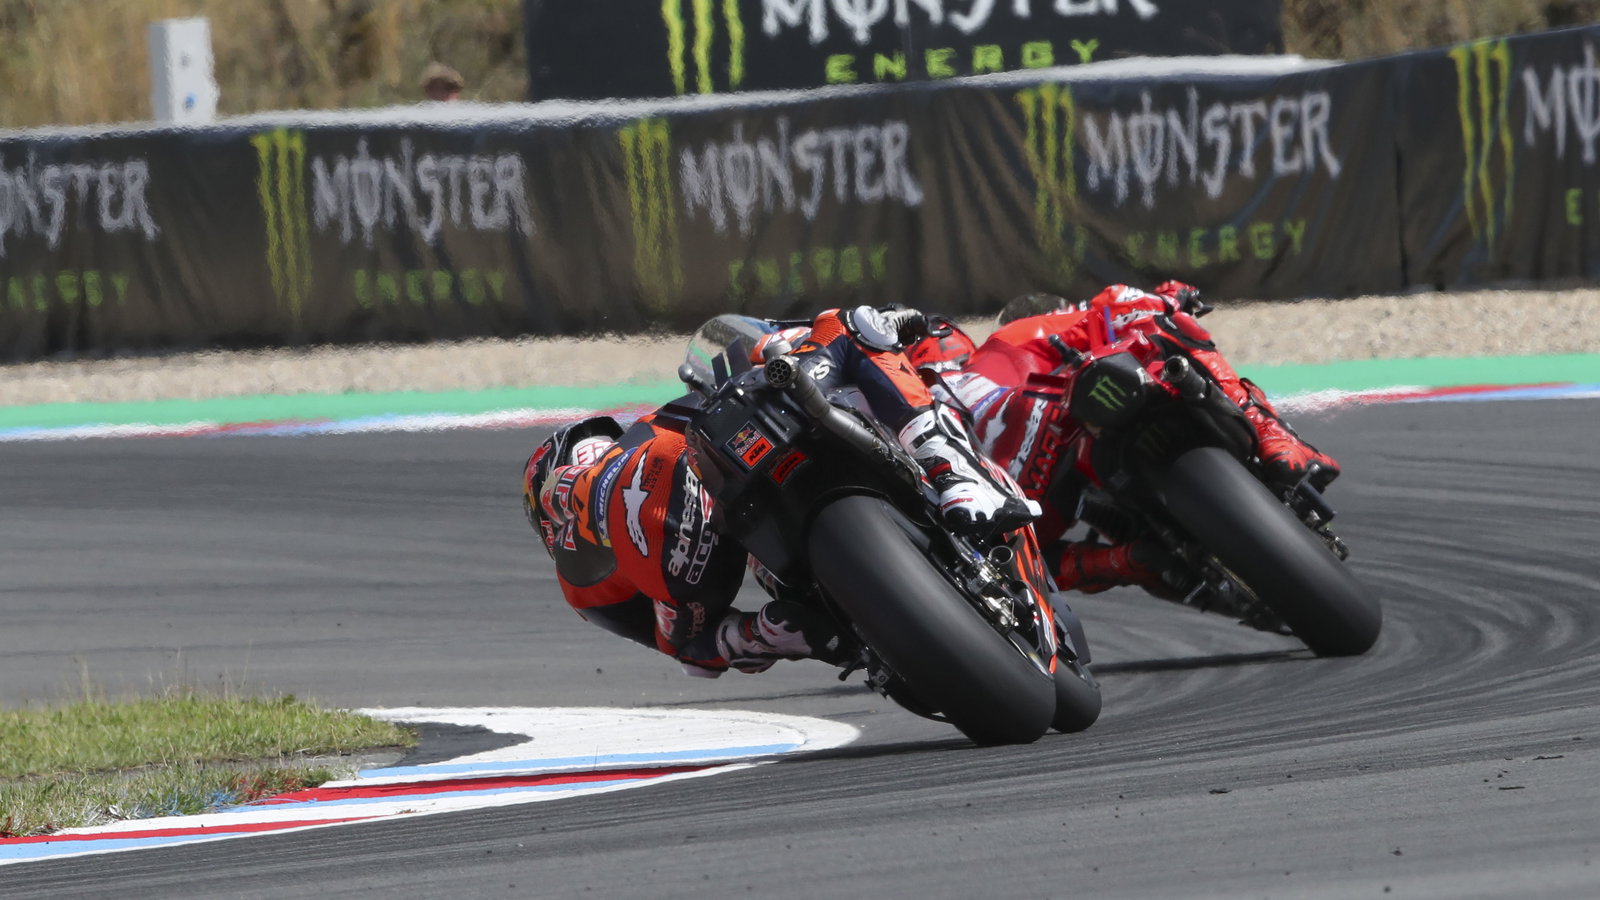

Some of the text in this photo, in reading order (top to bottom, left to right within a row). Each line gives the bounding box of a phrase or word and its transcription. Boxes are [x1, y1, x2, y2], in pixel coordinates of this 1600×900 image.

[824, 38, 1099, 84] ENERGY
[1522, 42, 1600, 165] MO
[311, 137, 537, 248] MONSTER
[680, 116, 923, 237] MONSTER
[1083, 87, 1341, 209] MONSTER
[0, 150, 160, 258] ONSTER
[599, 453, 629, 517] MICHELIN
